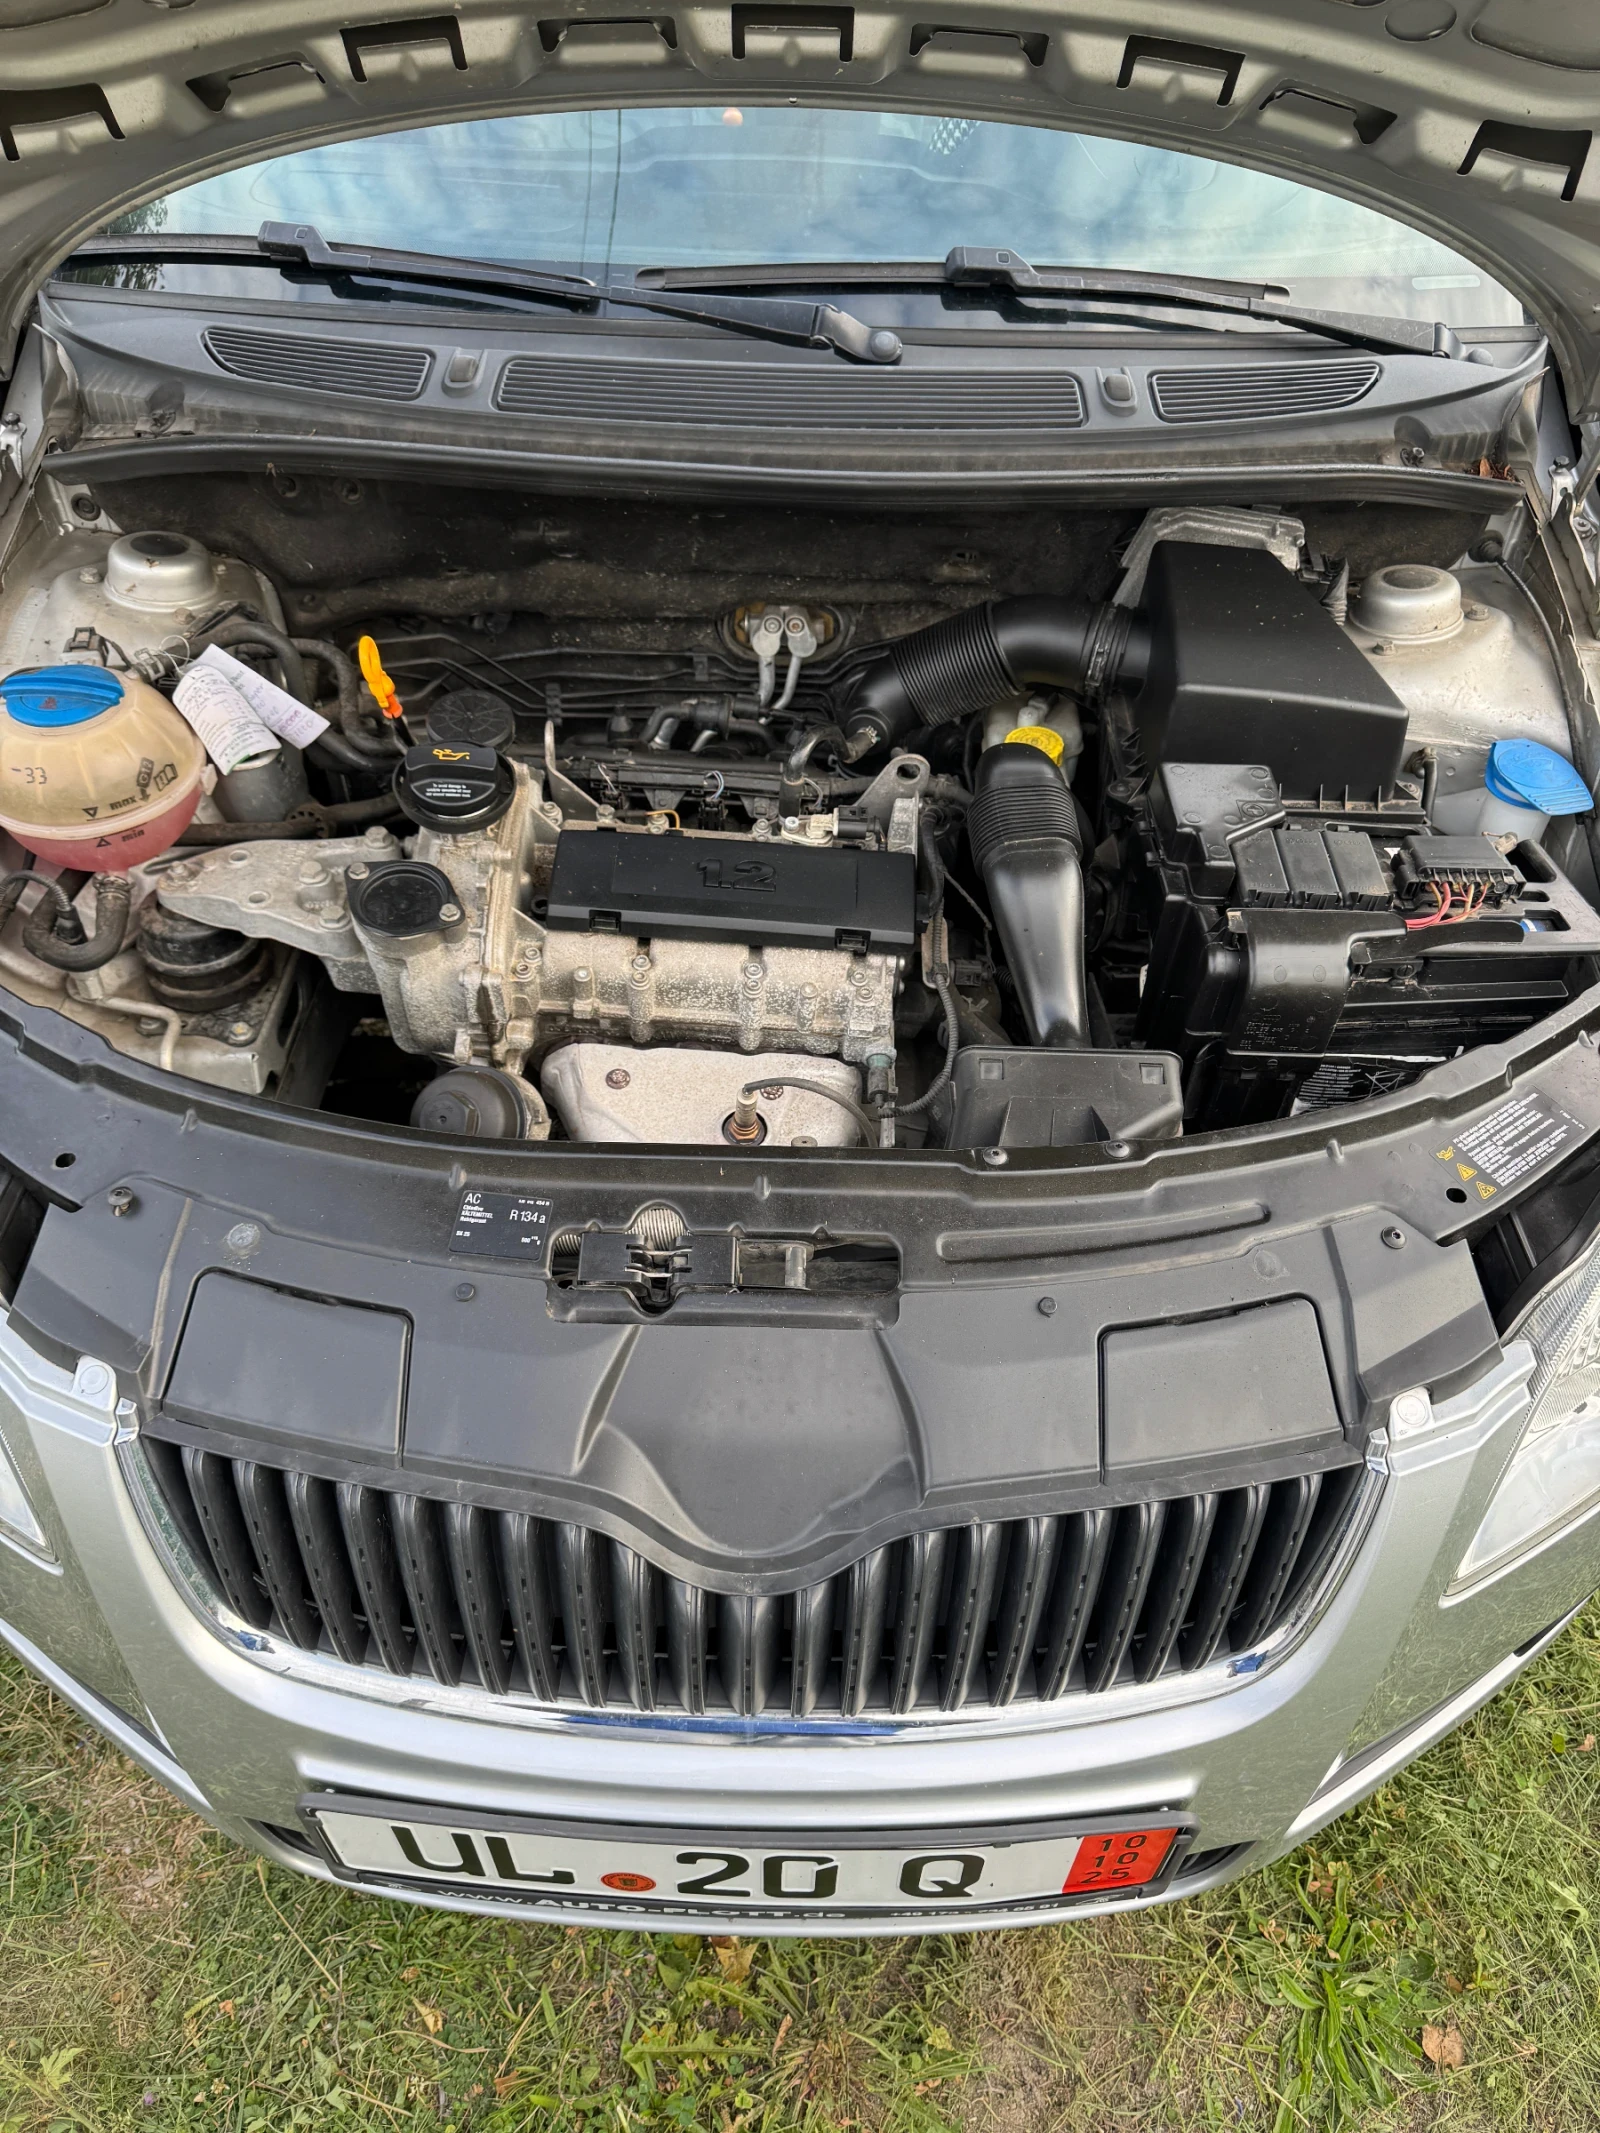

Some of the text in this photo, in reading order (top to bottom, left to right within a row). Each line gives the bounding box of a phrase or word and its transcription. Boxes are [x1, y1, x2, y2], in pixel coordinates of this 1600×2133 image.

[11, 766, 47, 785] -33
[137, 758, 153, 787] G12
[109, 796, 137, 810] max
[121, 828, 145, 842] min
[697, 859, 777, 892] 1.2
[464, 1193, 481, 1204] AC
[509, 1209, 519, 1221] R
[1102, 1835, 1148, 1852] 10
[390, 1825, 576, 1885] UL
[676, 1851, 840, 1899] 20
[900, 1854, 985, 1898] Q
[1095, 1852, 1140, 1868] 10
[1081, 1867, 1131, 1884] 25
